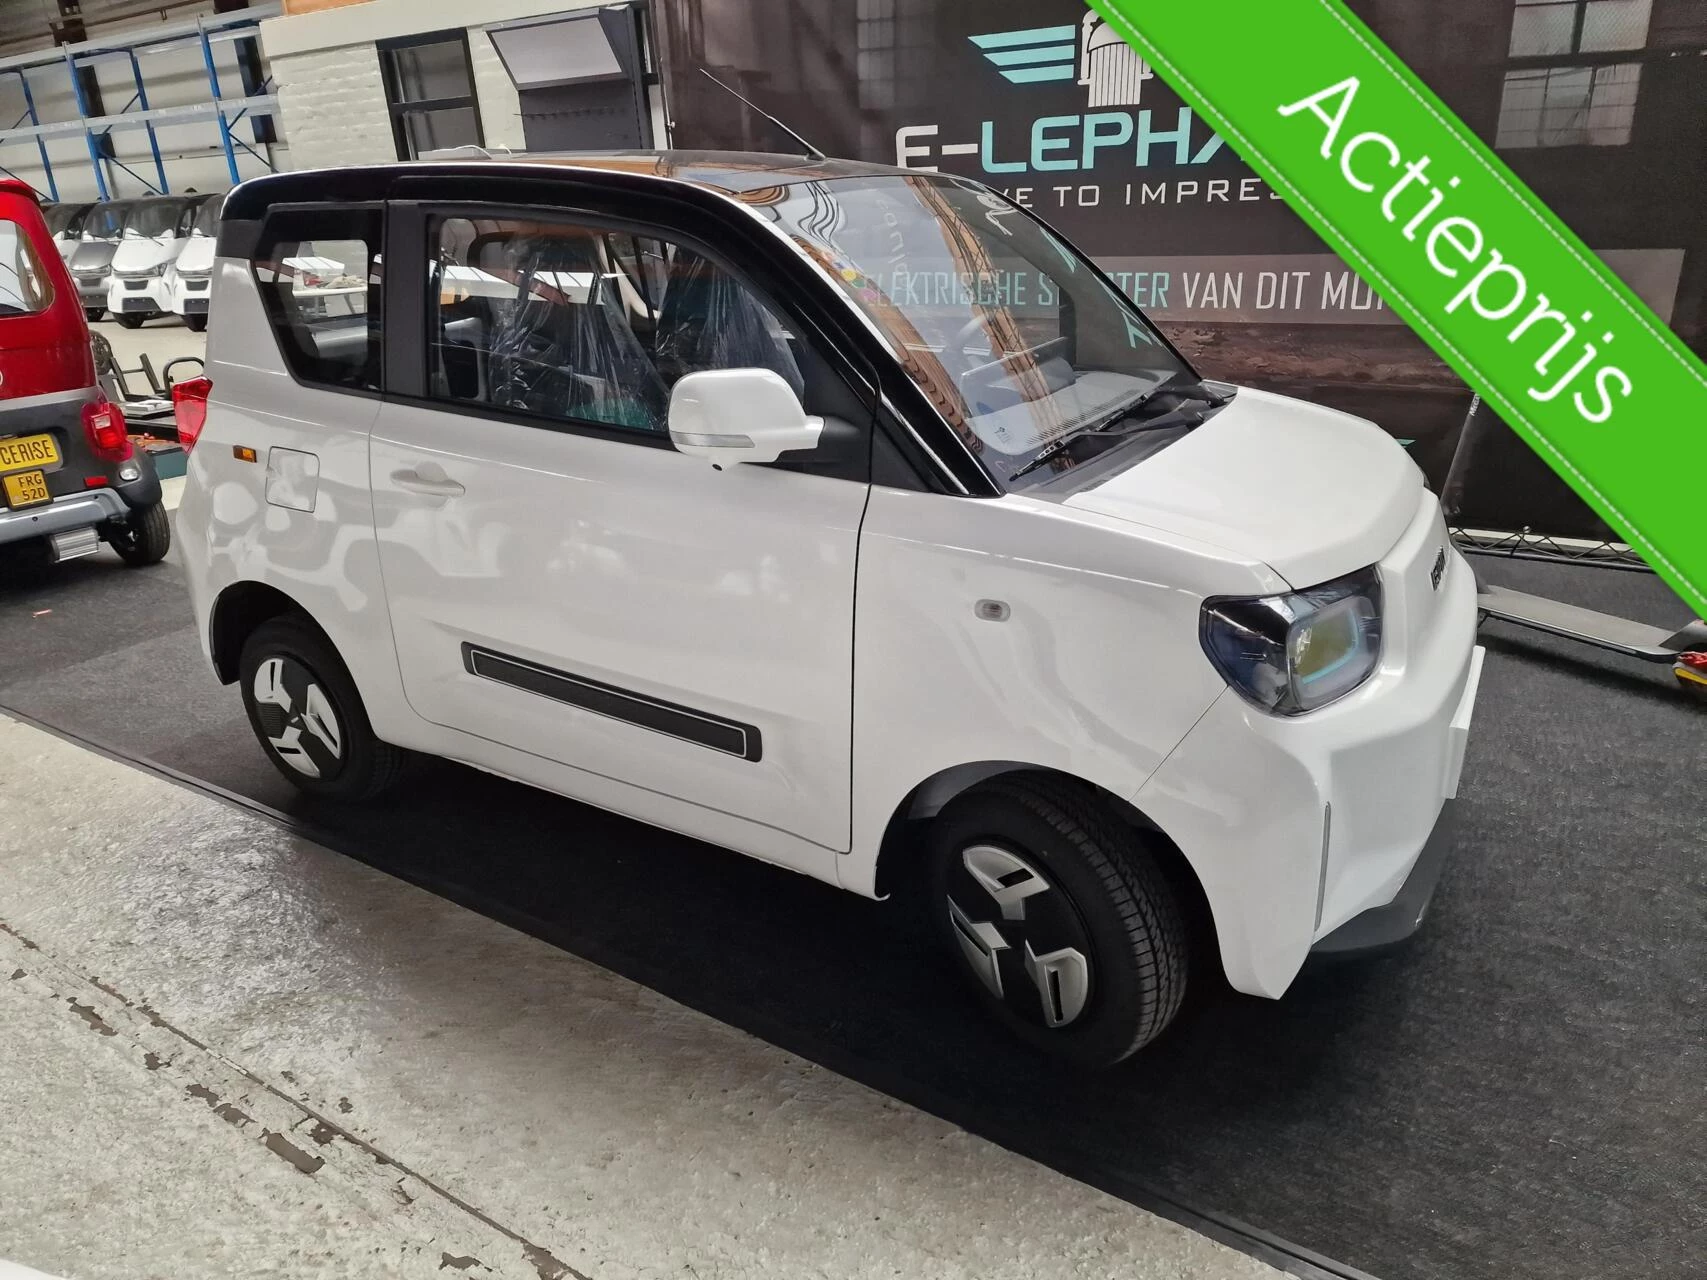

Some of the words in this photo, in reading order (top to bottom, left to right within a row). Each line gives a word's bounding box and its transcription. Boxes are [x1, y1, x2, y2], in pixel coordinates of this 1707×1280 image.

[1053, 185, 1100, 207] TO
[1183, 272, 1243, 309] VAN
[1256, 272, 1310, 309] DIT
[0, 440, 53, 465] CERISE
[17, 473, 42, 488] FRG
